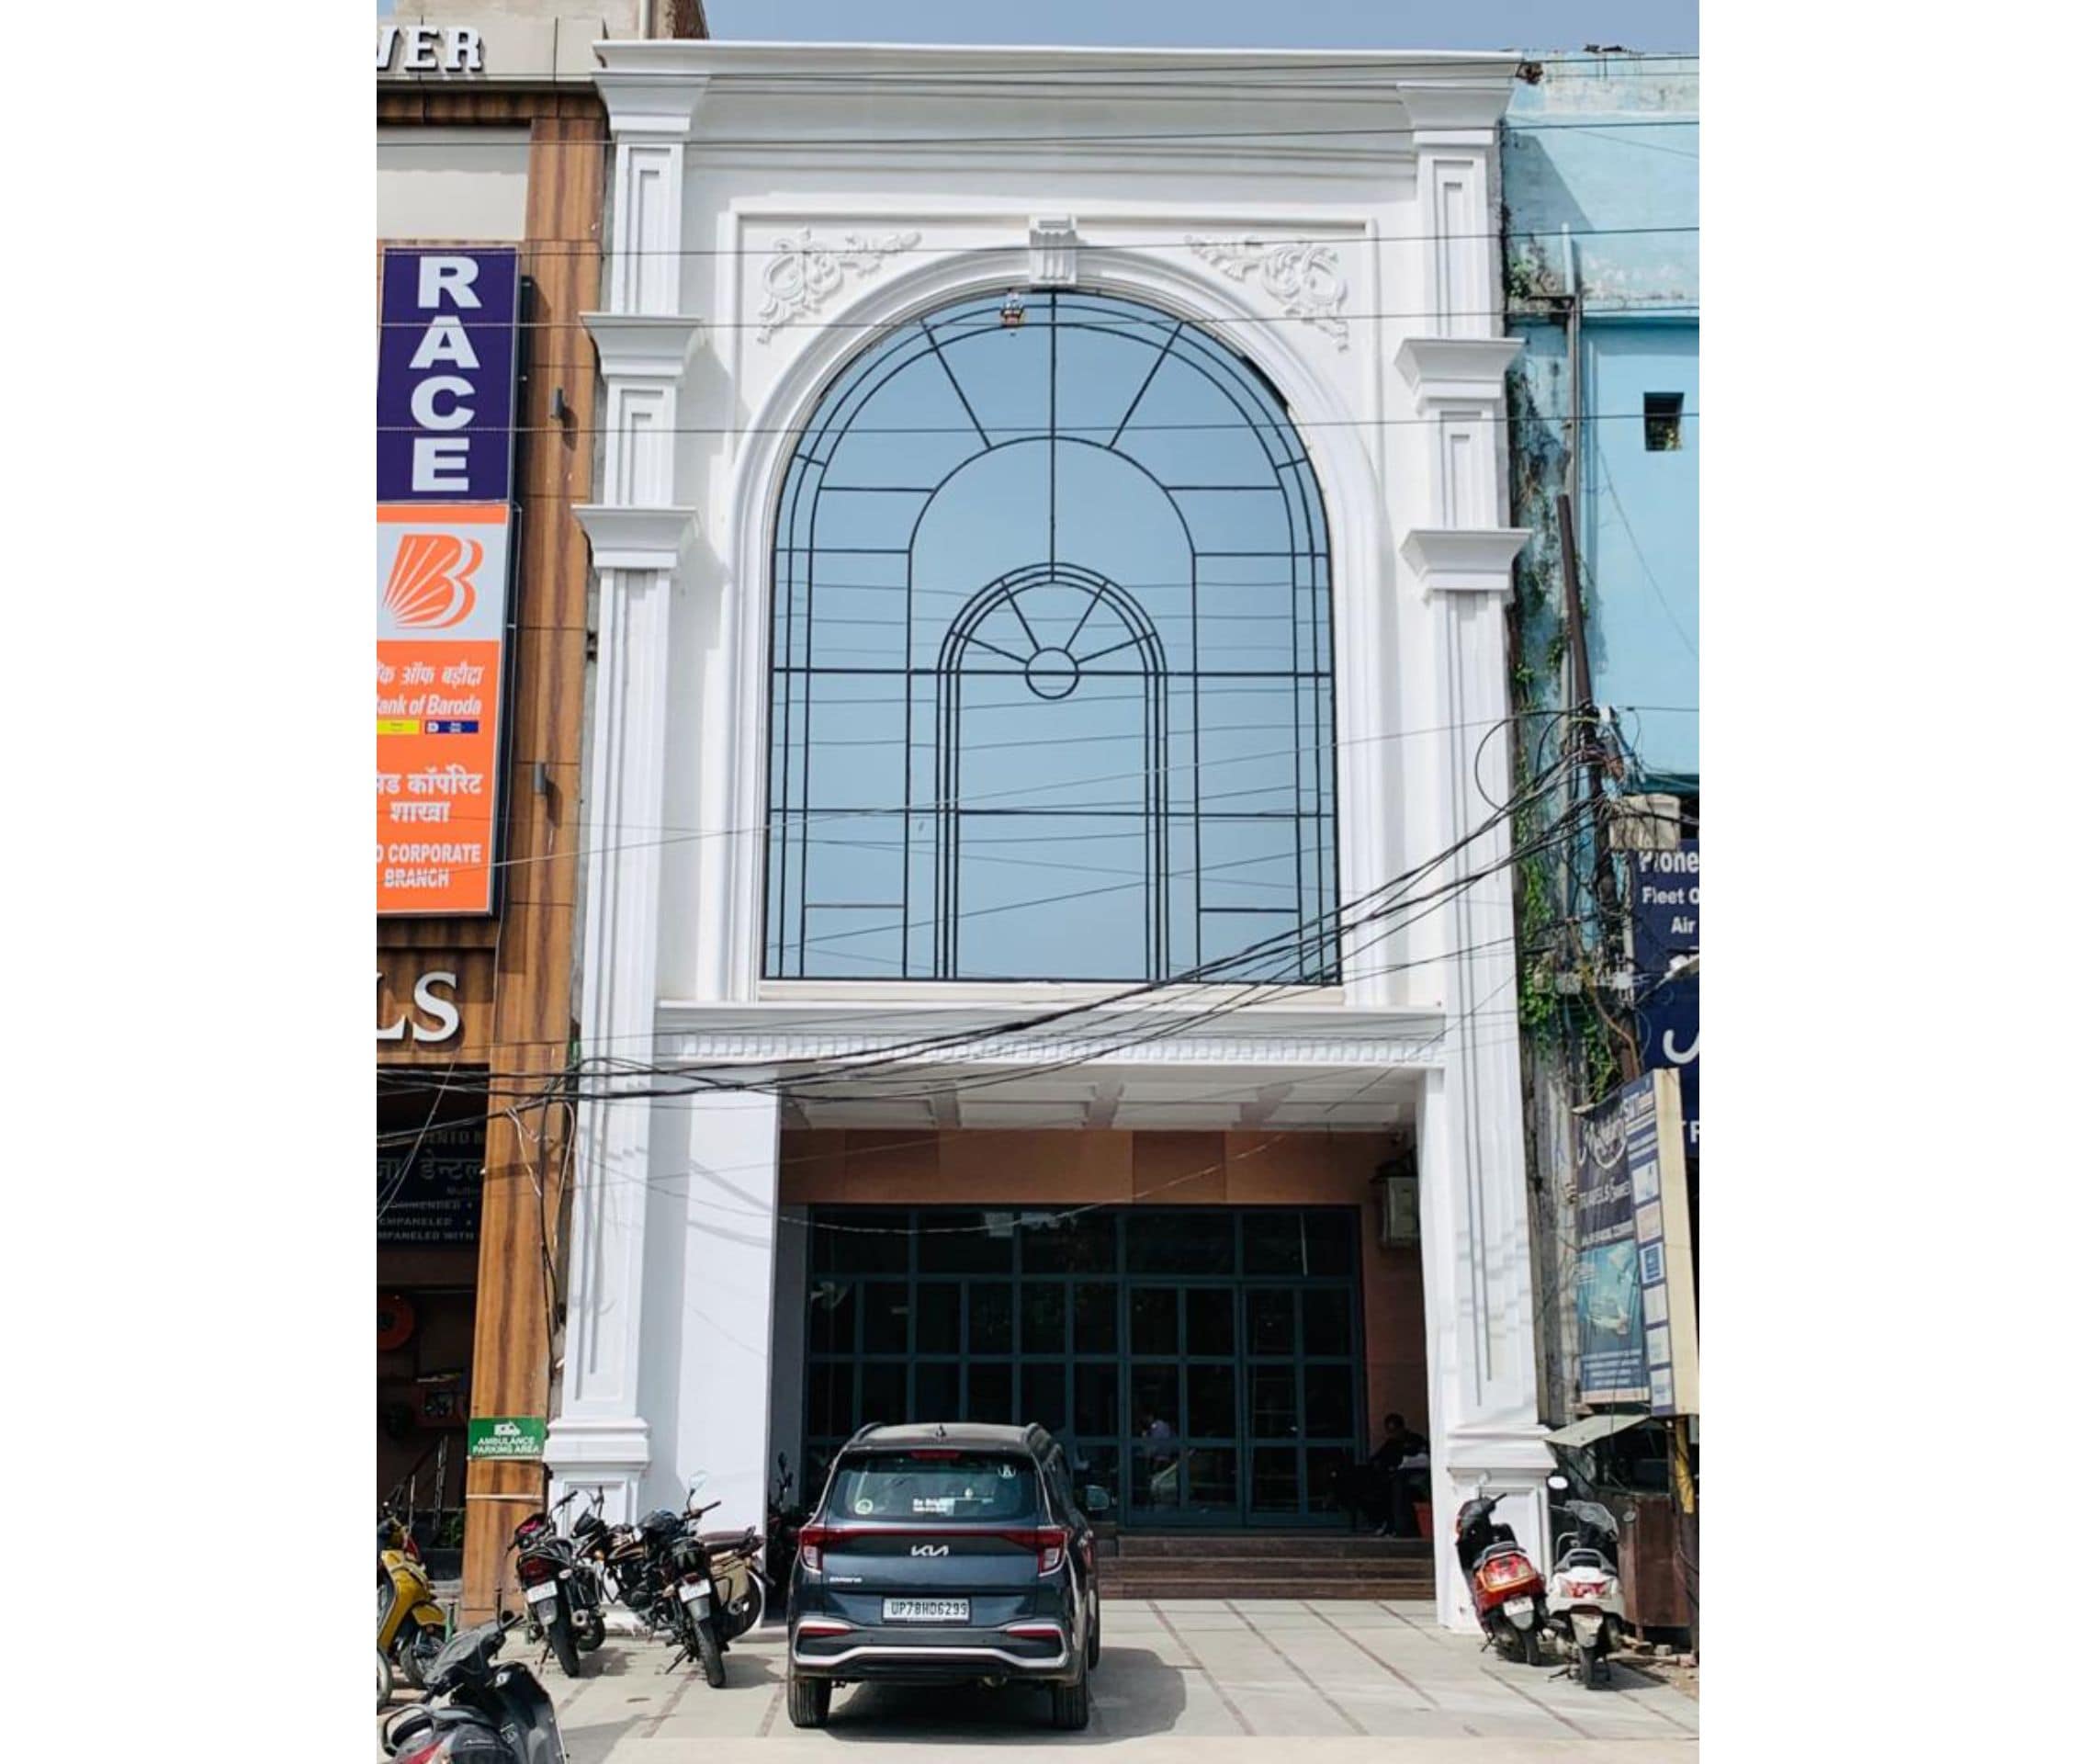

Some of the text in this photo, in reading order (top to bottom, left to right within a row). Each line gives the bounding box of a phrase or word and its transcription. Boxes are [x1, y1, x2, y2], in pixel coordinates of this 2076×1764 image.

[409, 255, 482, 492] RACE
[377, 693, 482, 716] ank of Baroda
[389, 842, 482, 863] CORPORATE
[384, 867, 450, 888] BRANCH
[1642, 887, 1686, 905] Fleet
[1671, 916, 1697, 934] Air
[478, 1436, 536, 1446] AMBULANCE
[911, 1544, 949, 1556] KIA
